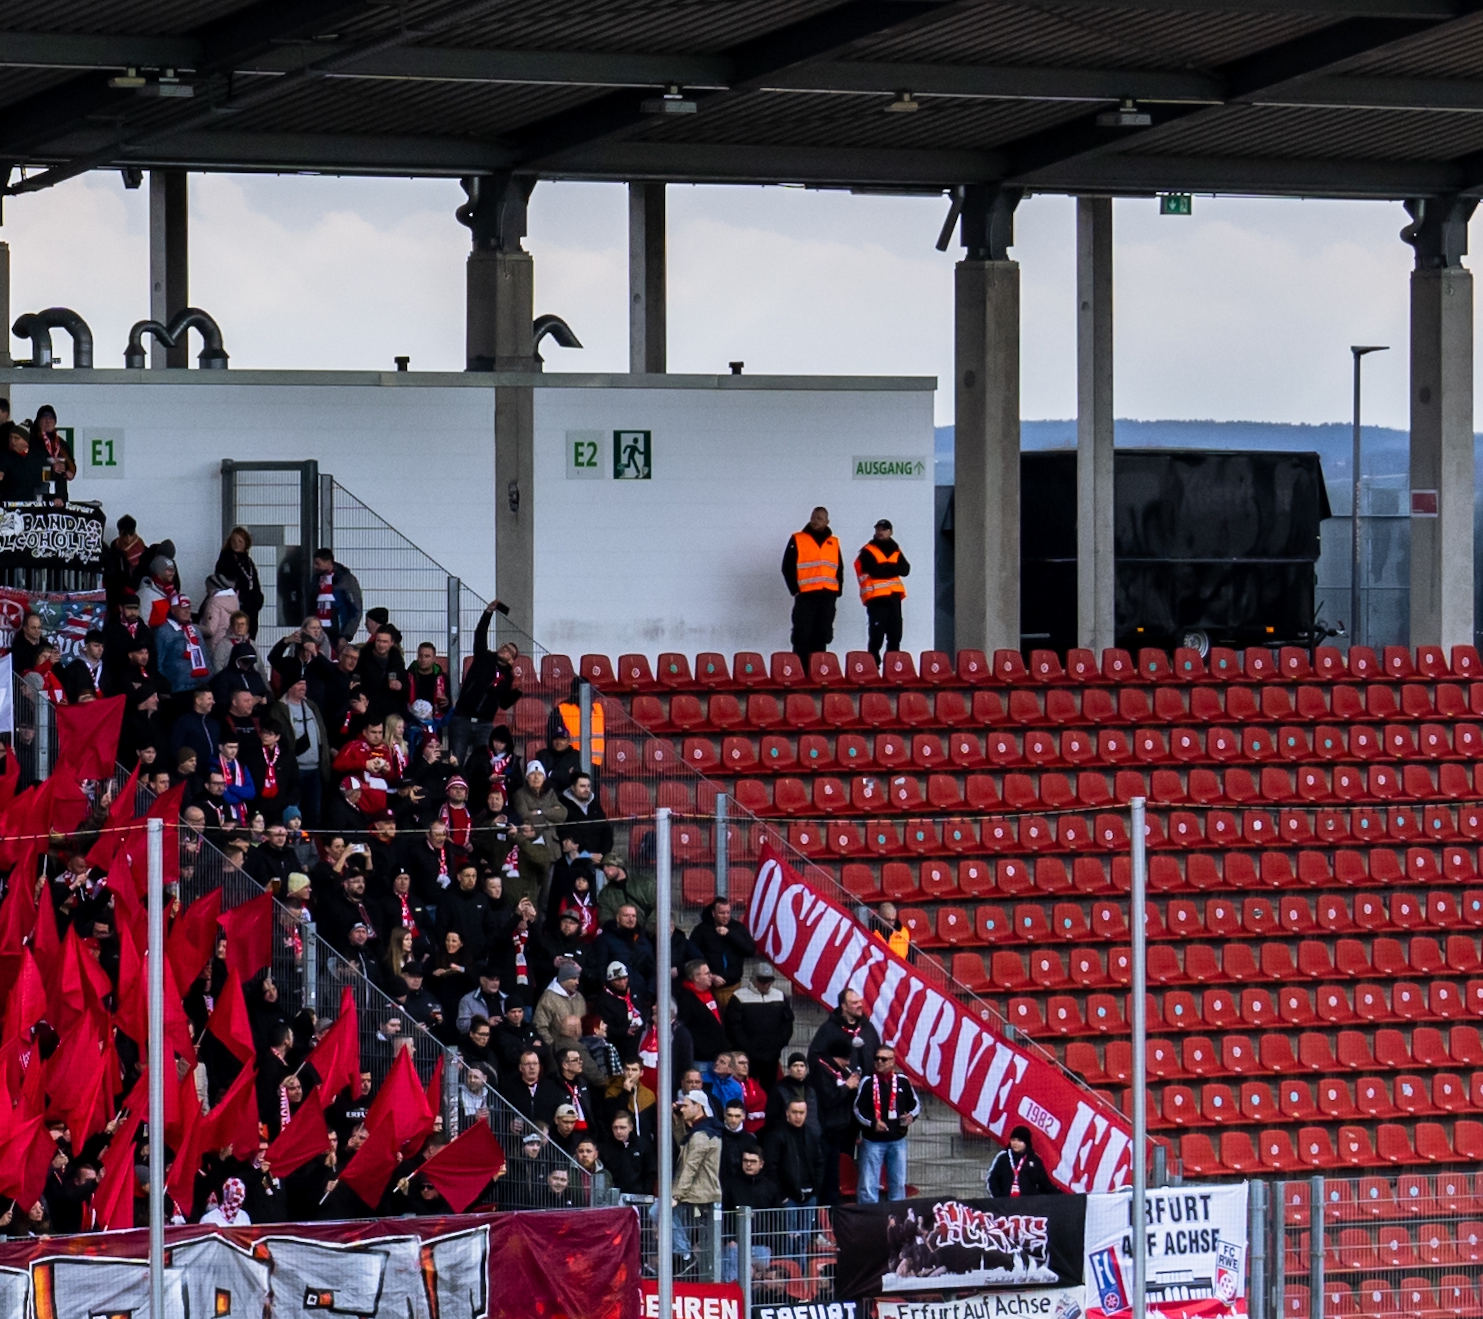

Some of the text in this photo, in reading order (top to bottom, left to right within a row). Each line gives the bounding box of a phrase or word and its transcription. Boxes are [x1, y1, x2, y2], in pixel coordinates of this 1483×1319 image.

[91, 439, 117, 466] E1
[573, 441, 598, 468] E2
[855, 461, 913, 476] AUSGANG
[22, 513, 87, 533] BANDA
[1022, 1101, 1056, 1135] 1982
[1222, 1245, 1236, 1259] FC
[1218, 1257, 1239, 1271] RWE
[996, 1294, 1052, 1317] Achse
